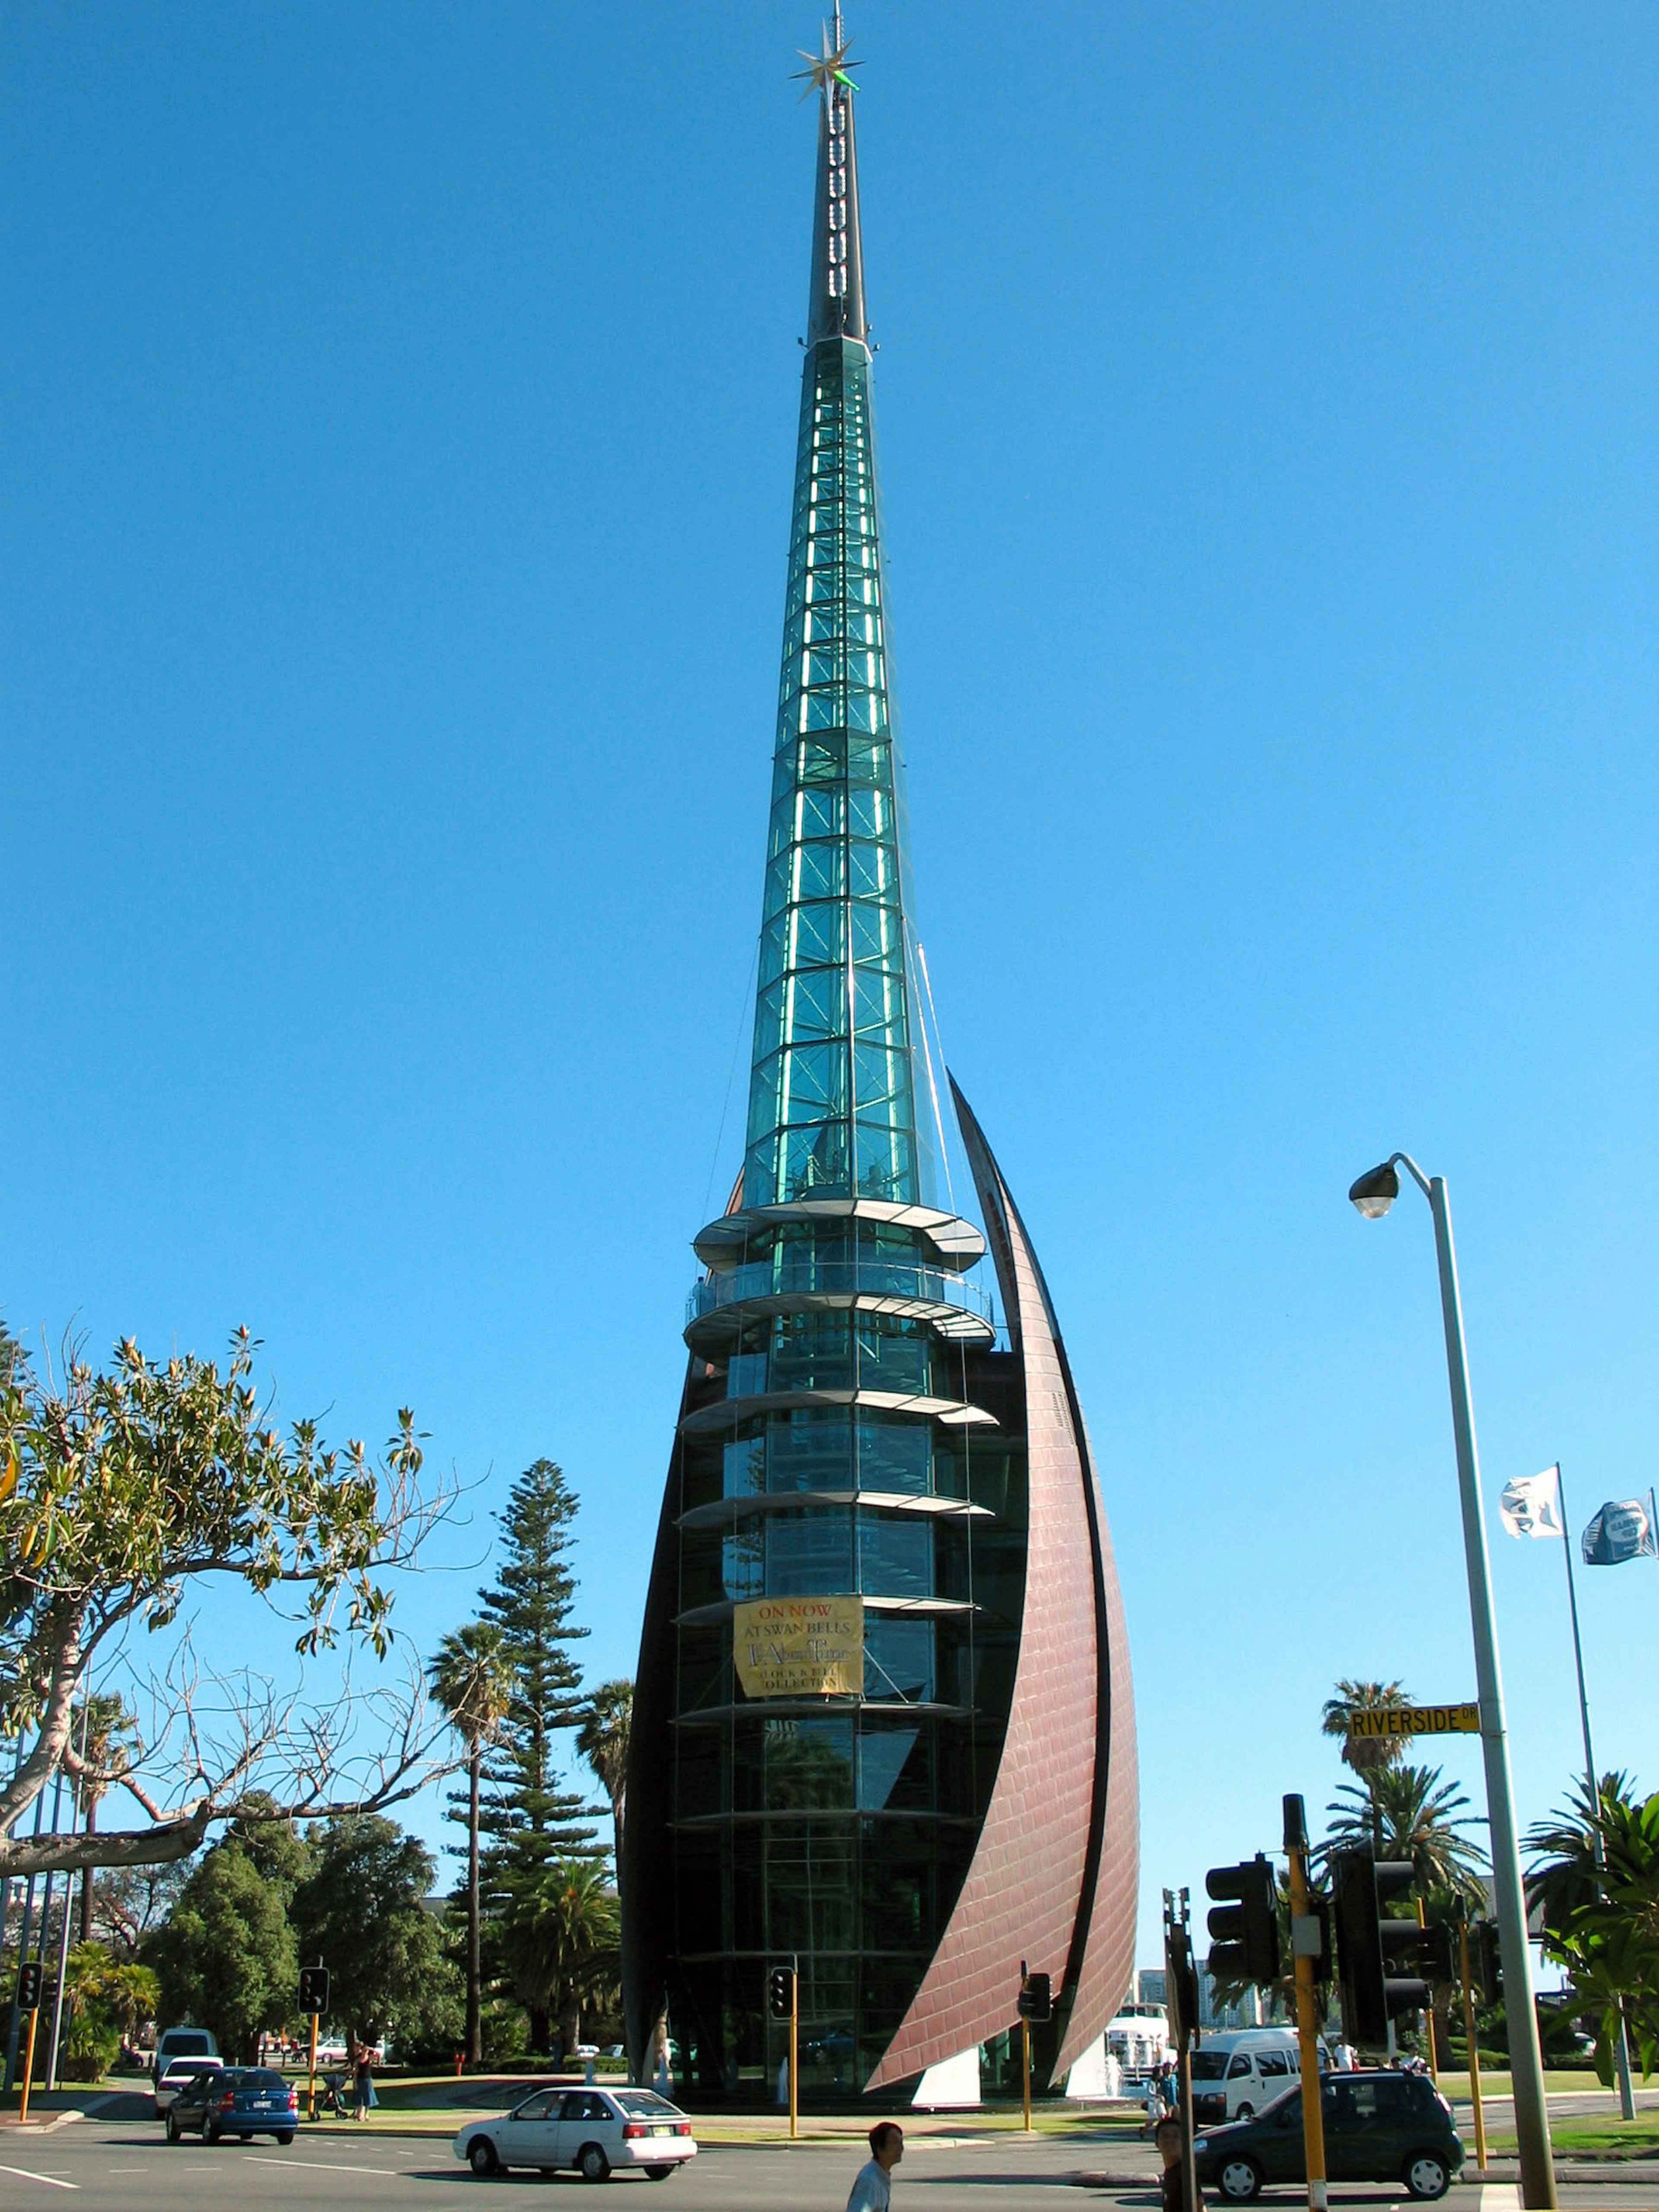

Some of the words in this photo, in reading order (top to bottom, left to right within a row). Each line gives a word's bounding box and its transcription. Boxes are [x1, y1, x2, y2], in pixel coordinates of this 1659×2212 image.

[760, 1606, 784, 1620] ON
[790, 1604, 832, 1618] NOW
[745, 1627, 760, 1638] AT
[764, 1623, 803, 1636] SWAN
[807, 1622, 850, 1634] BELLS
[1353, 1709, 1461, 1736] RIVERSIDE
